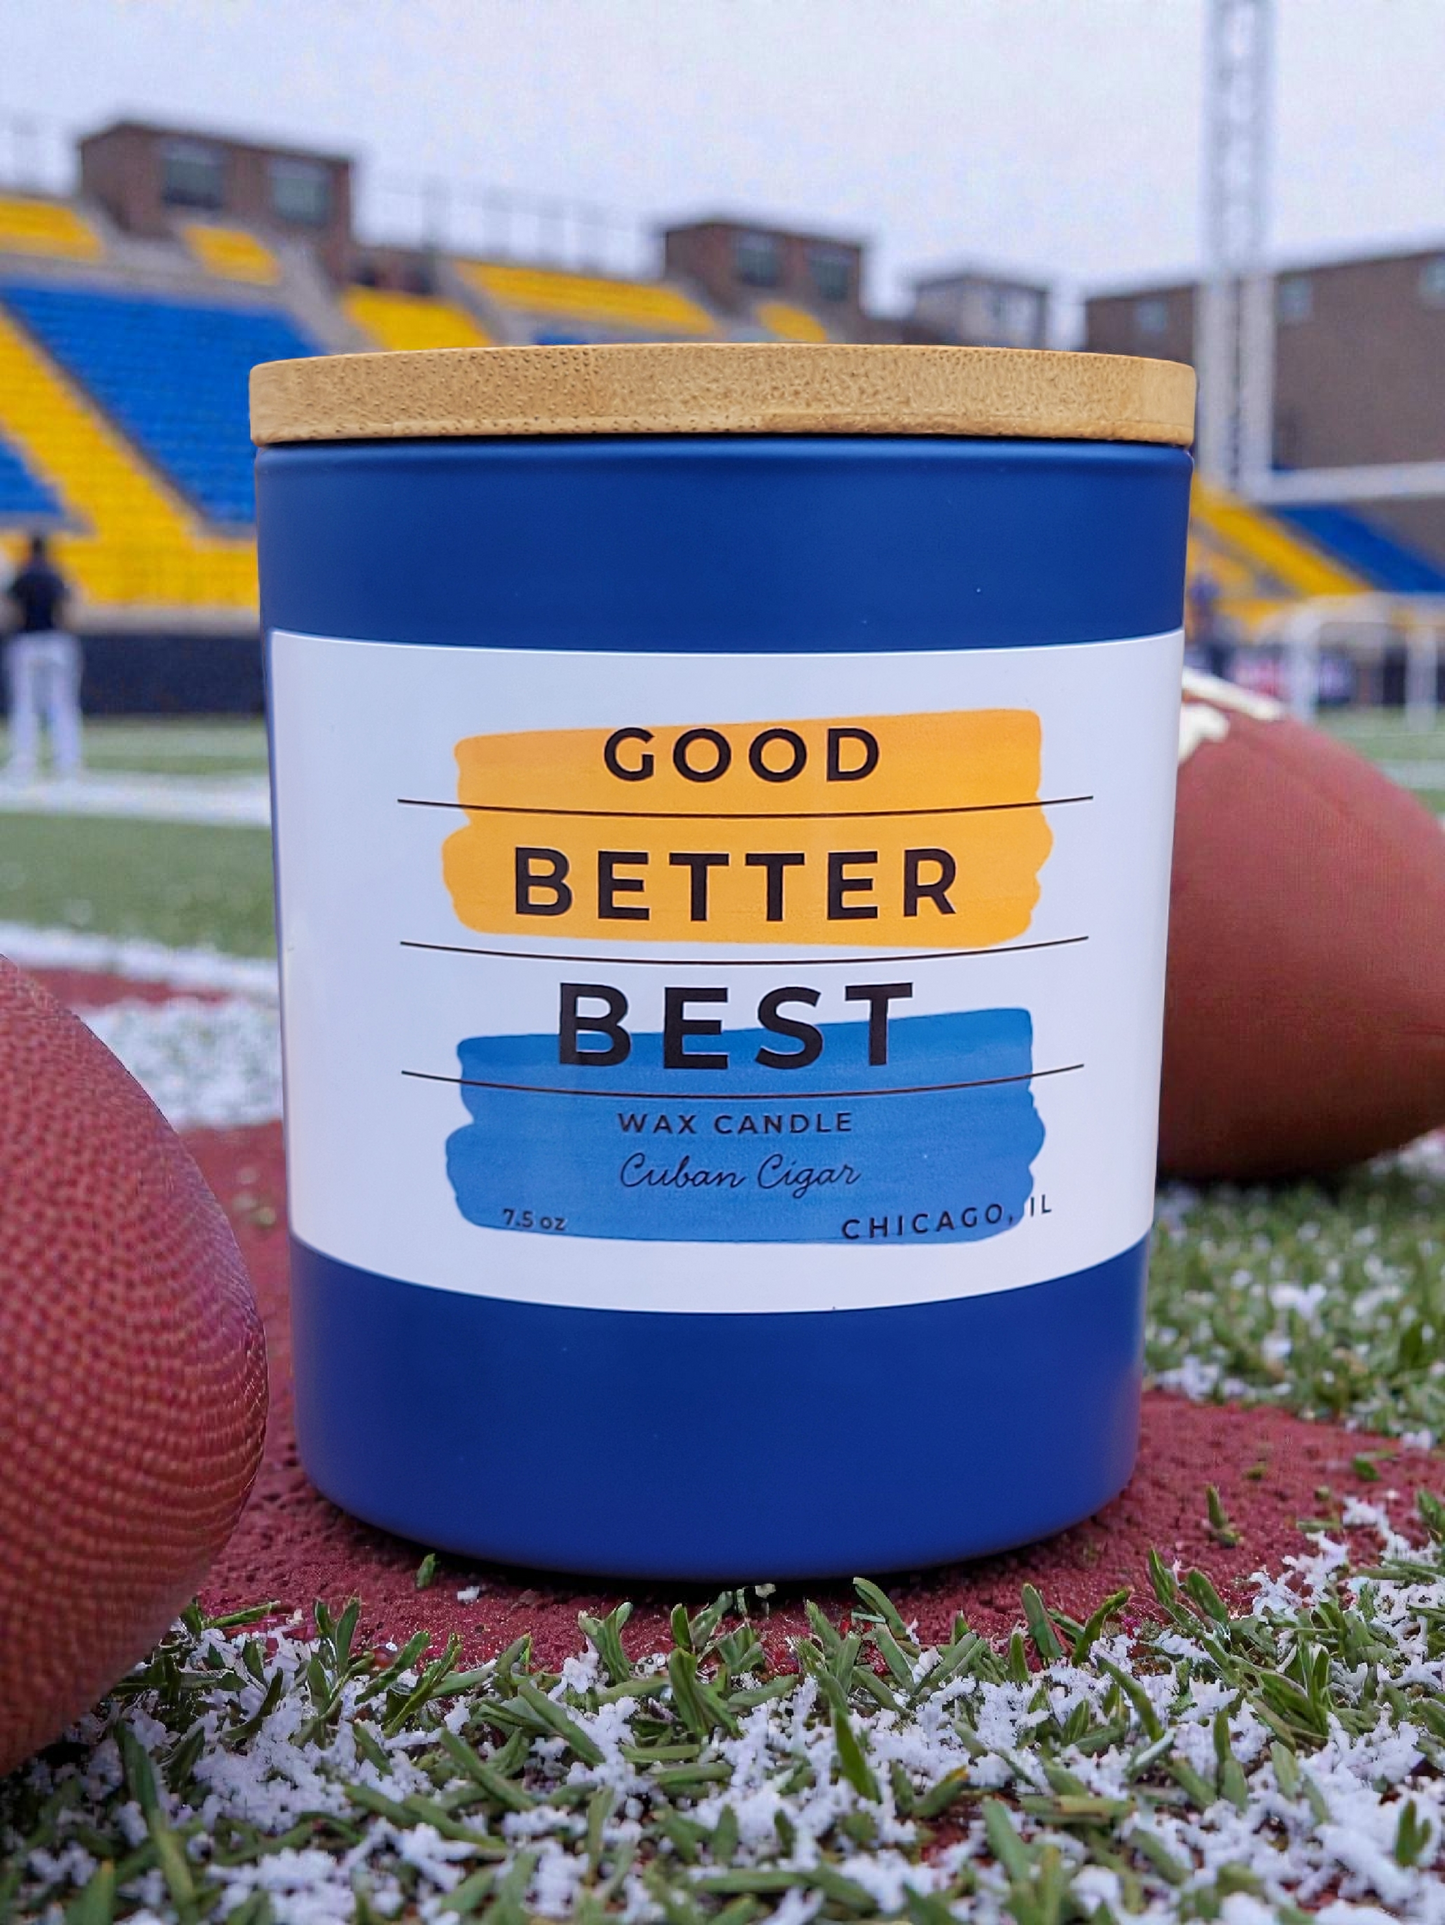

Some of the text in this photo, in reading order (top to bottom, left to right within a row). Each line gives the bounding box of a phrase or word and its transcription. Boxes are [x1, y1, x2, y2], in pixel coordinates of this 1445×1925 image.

[603, 726, 880, 784] GOOD
[514, 846, 957, 923] BETTER
[558, 982, 914, 1070] BEST
[617, 1112, 853, 1135] WAX CANDLE
[619, 1151, 862, 1200] Cuban Cigar
[503, 1208, 566, 1232] 7.5 oz
[840, 1193, 1053, 1241] CHICAGO, IL
